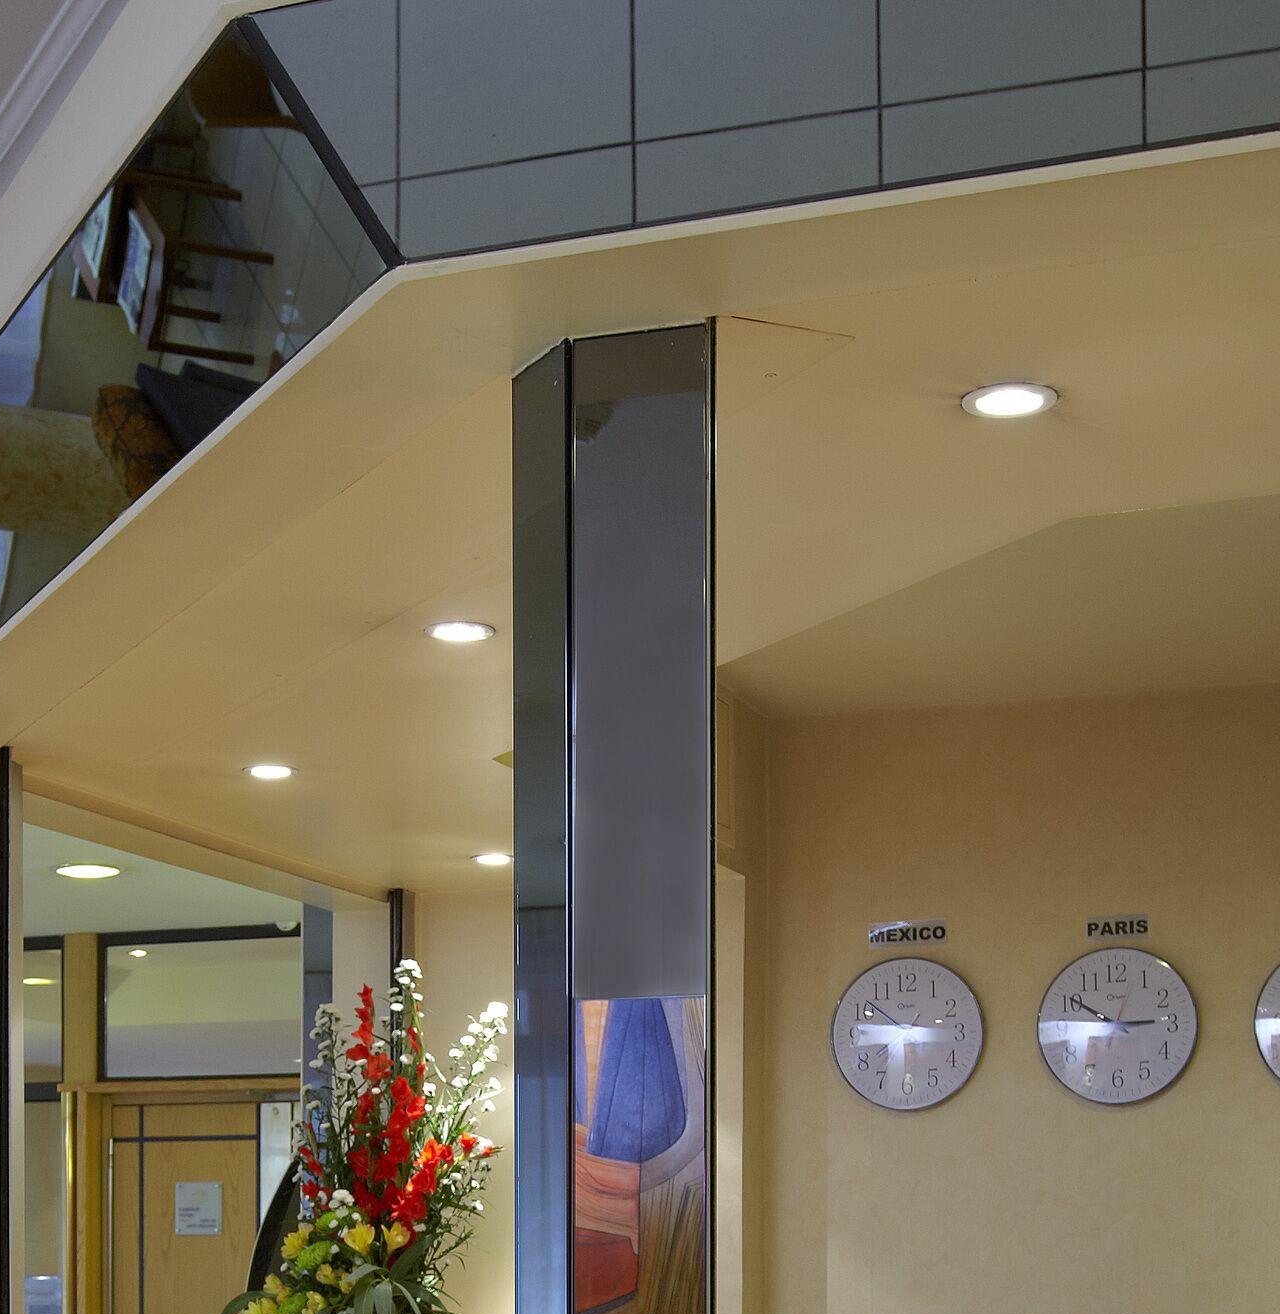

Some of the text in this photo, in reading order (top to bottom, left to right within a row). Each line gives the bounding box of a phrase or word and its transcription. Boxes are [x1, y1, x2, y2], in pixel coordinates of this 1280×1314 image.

[869, 926, 946, 943] MEXICO
[1087, 920, 1148, 936] PARIS
[896, 973, 917, 992] 12
[1081, 973, 1099, 991] 11
[1105, 963, 1127, 983] 12
[1140, 970, 1148, 989] 1
[873, 982, 890, 1000] 11
[929, 980, 936, 998] 1
[1157, 989, 1169, 1008] 2
[855, 1002, 874, 1021] 10
[945, 999, 957, 1017] 2
[1062, 994, 1083, 1013] 10
[954, 1023, 965, 1041] 3
[1056, 1018, 1068, 1038] 9
[1167, 1013, 1179, 1033] 3
[945, 1049, 958, 1068] 4
[1065, 1044, 1077, 1064] 8
[1158, 1041, 1169, 1060] 4
[857, 1052, 869, 1071] 8
[1139, 1061, 1150, 1080] 5
[876, 1071, 886, 1090] 7
[927, 1068, 938, 1087] 5
[1085, 1064, 1096, 1083] 7
[1112, 1069, 1124, 1088] 6
[902, 1075, 913, 1095] 6
